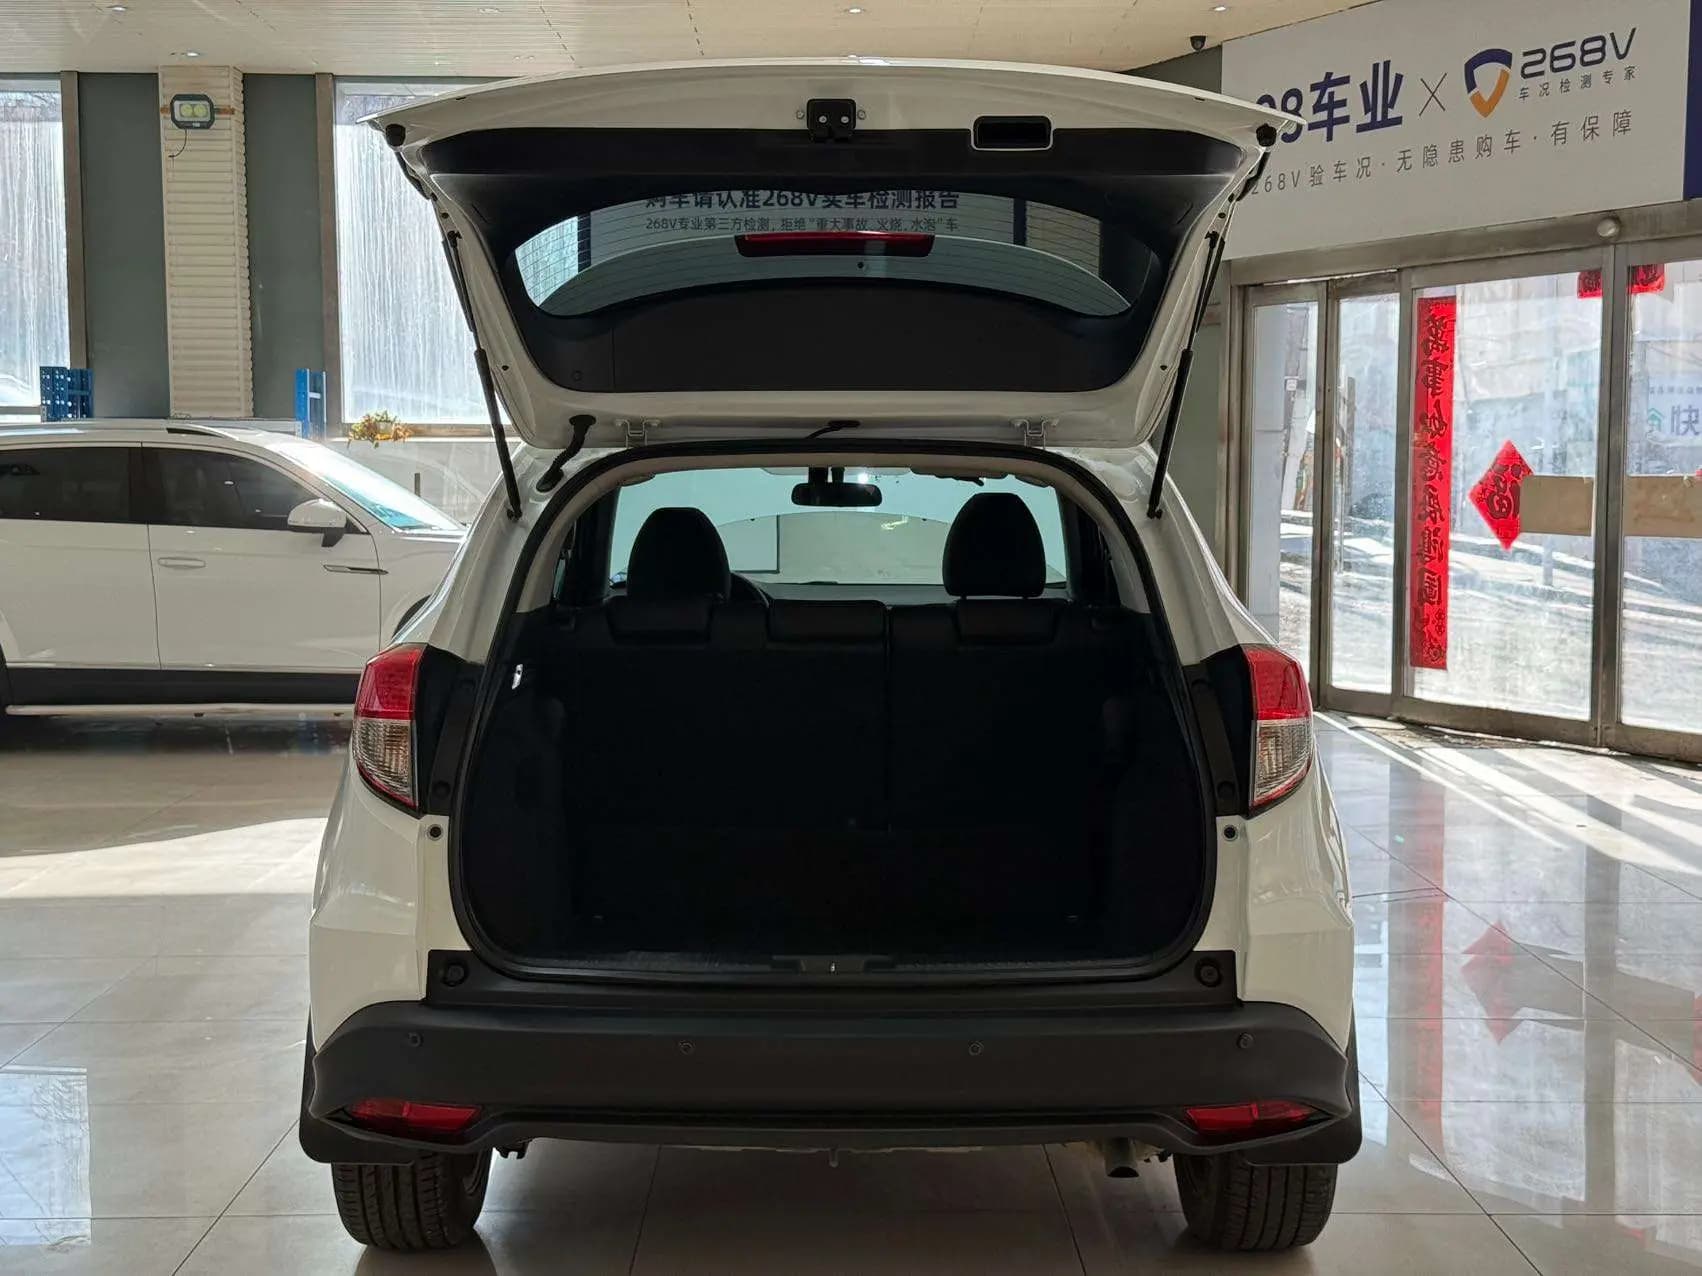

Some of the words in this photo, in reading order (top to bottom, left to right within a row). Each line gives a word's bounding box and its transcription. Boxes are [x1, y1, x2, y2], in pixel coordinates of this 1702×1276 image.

[1520, 27, 1637, 80] 268V
[1519, 65, 1637, 101] 车况检测专家
